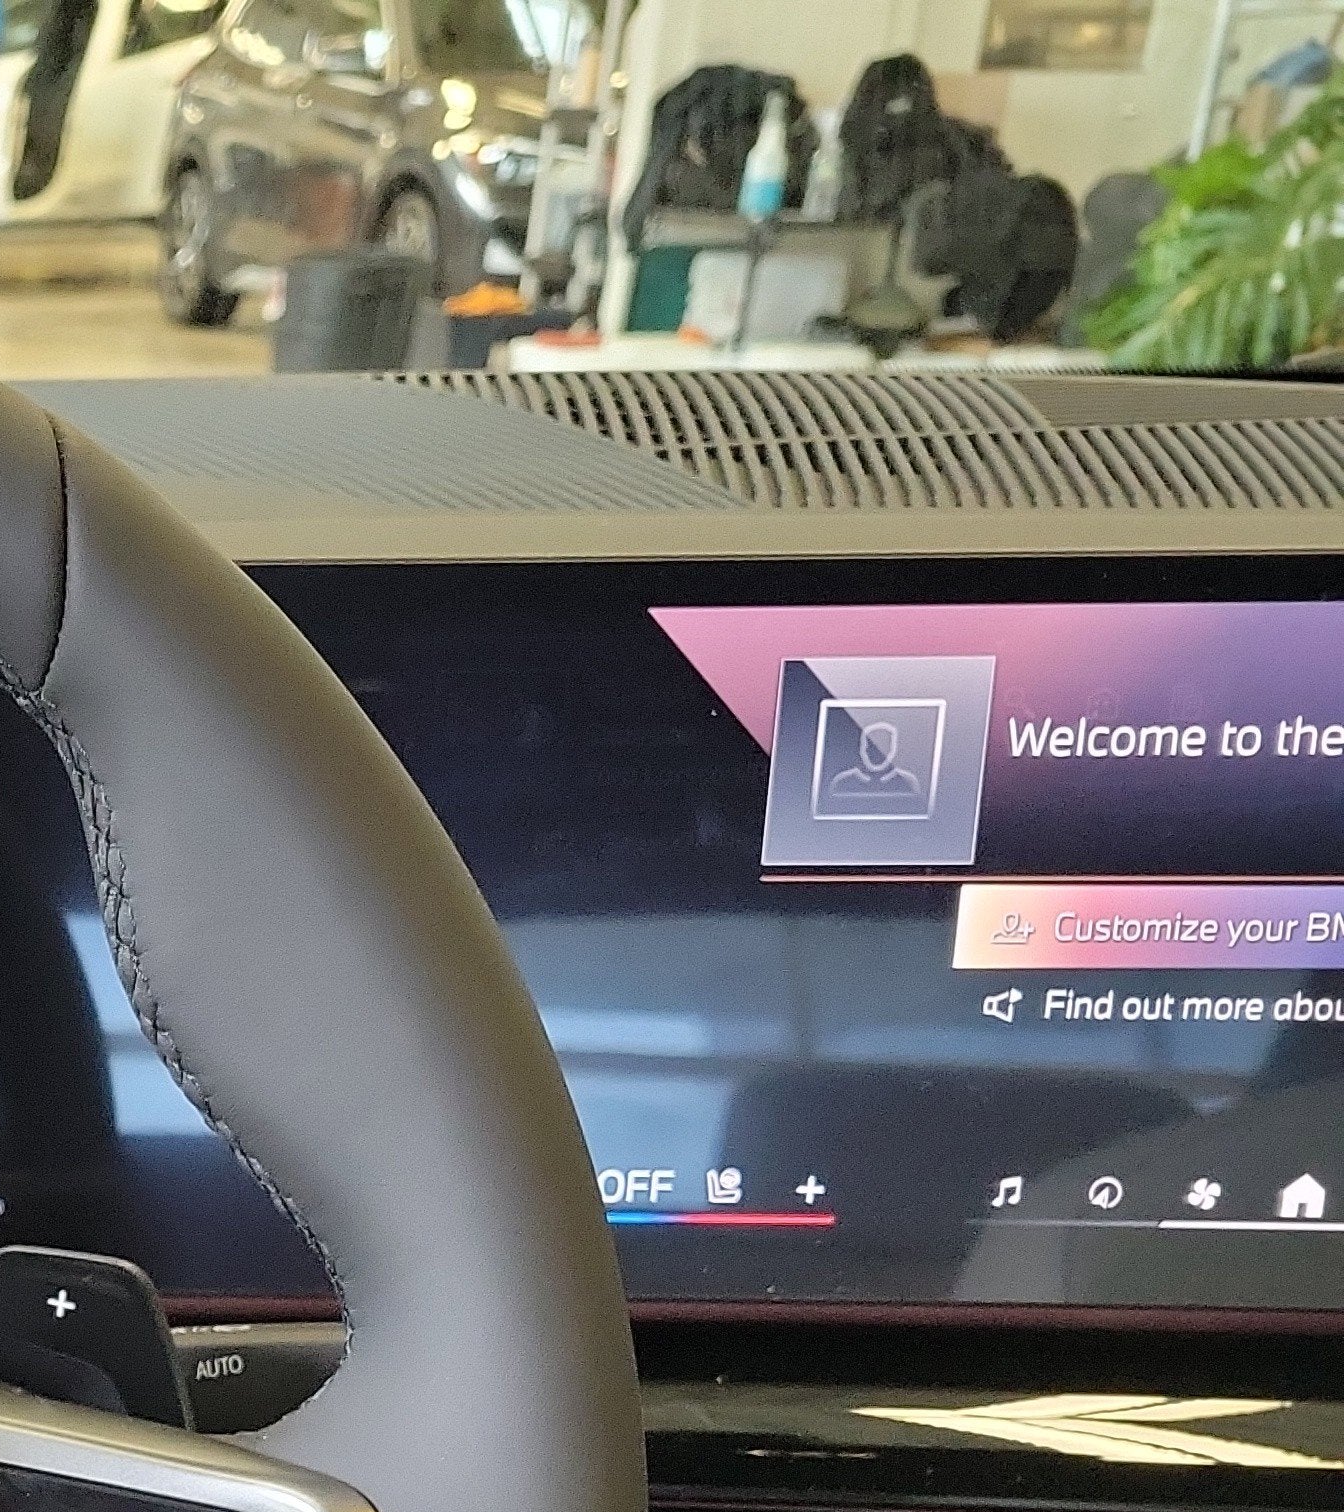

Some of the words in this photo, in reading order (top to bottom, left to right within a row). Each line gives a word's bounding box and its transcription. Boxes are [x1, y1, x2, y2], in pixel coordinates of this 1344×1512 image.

[1008, 715, 1207, 758] Welcome
[1221, 720, 1263, 758] to
[1277, 715, 1344, 757] the
[1053, 911, 1219, 943] Customize
[1227, 917, 1299, 948] your
[1043, 988, 1115, 1021] Find
[1122, 993, 1175, 1021] out
[1181, 995, 1265, 1021] more
[596, 1169, 676, 1204] OFF
[195, 1354, 244, 1381] AUTO
